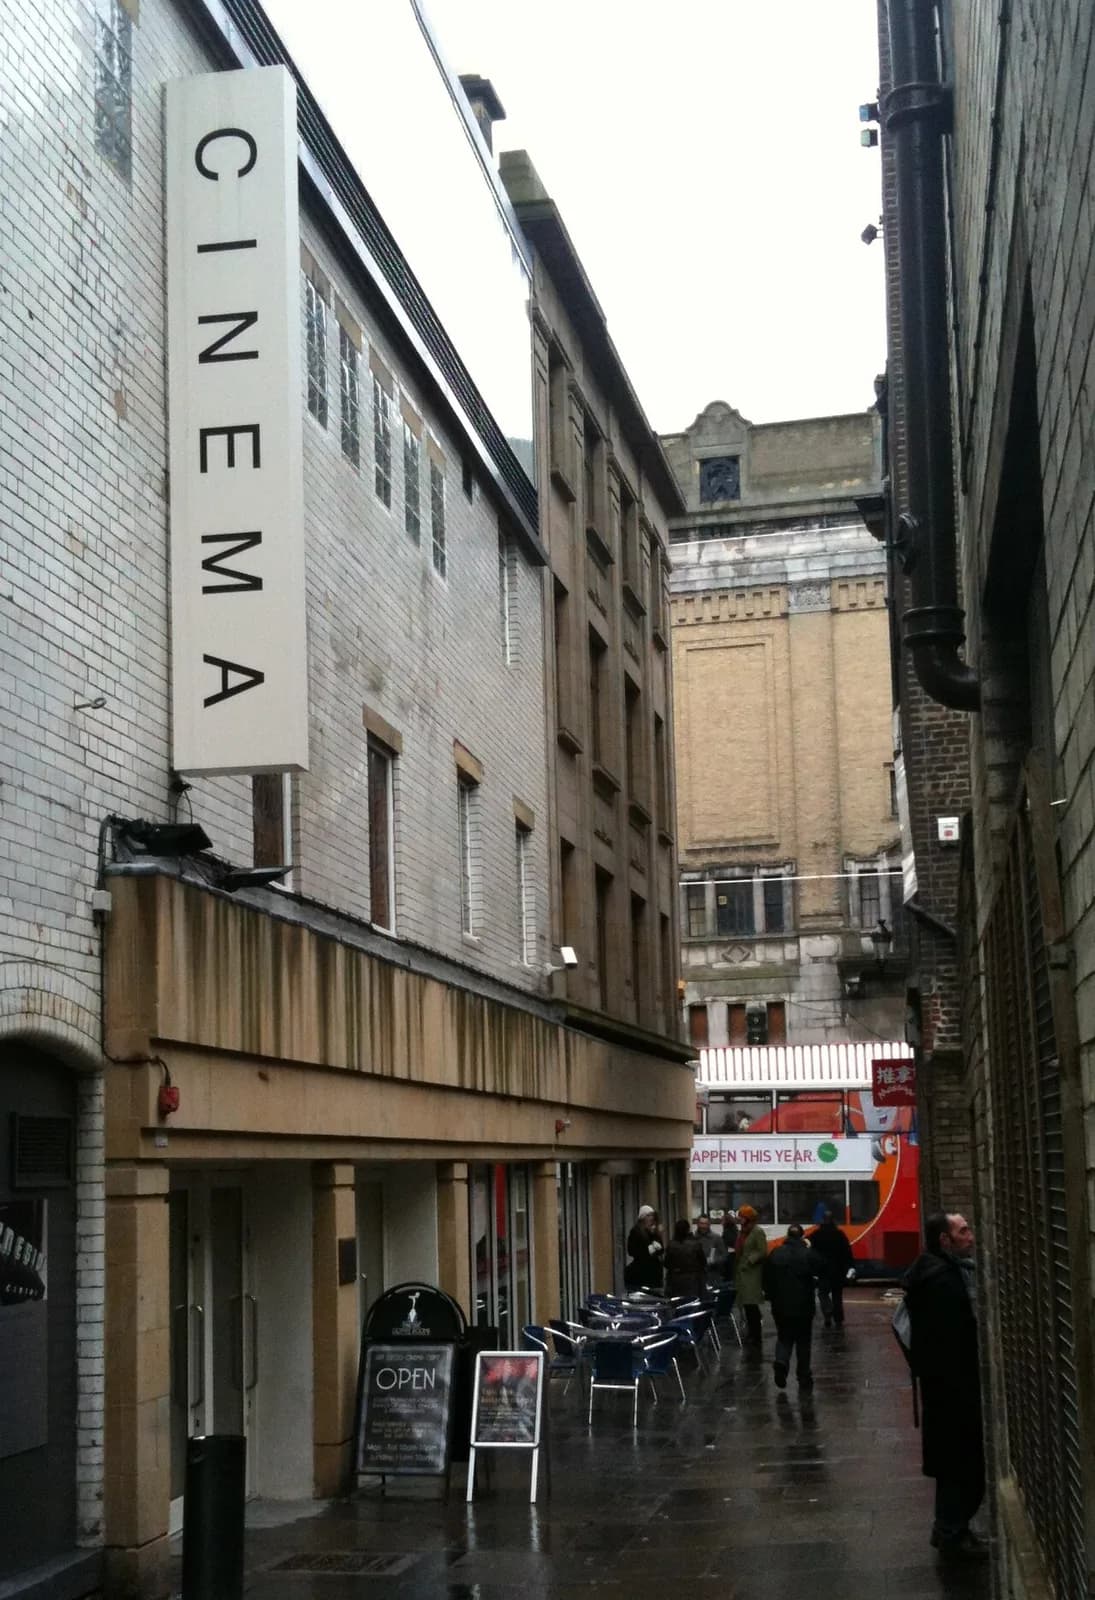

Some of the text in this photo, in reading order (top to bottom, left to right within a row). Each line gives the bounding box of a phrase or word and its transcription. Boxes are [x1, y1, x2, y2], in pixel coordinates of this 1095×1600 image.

[194, 127, 265, 708] CINEMA
[691, 1149, 736, 1163] APPEN
[742, 1149, 773, 1163] THIS
[776, 1149, 817, 1163] YEAR.
[376, 1367, 436, 1390] OPEN
